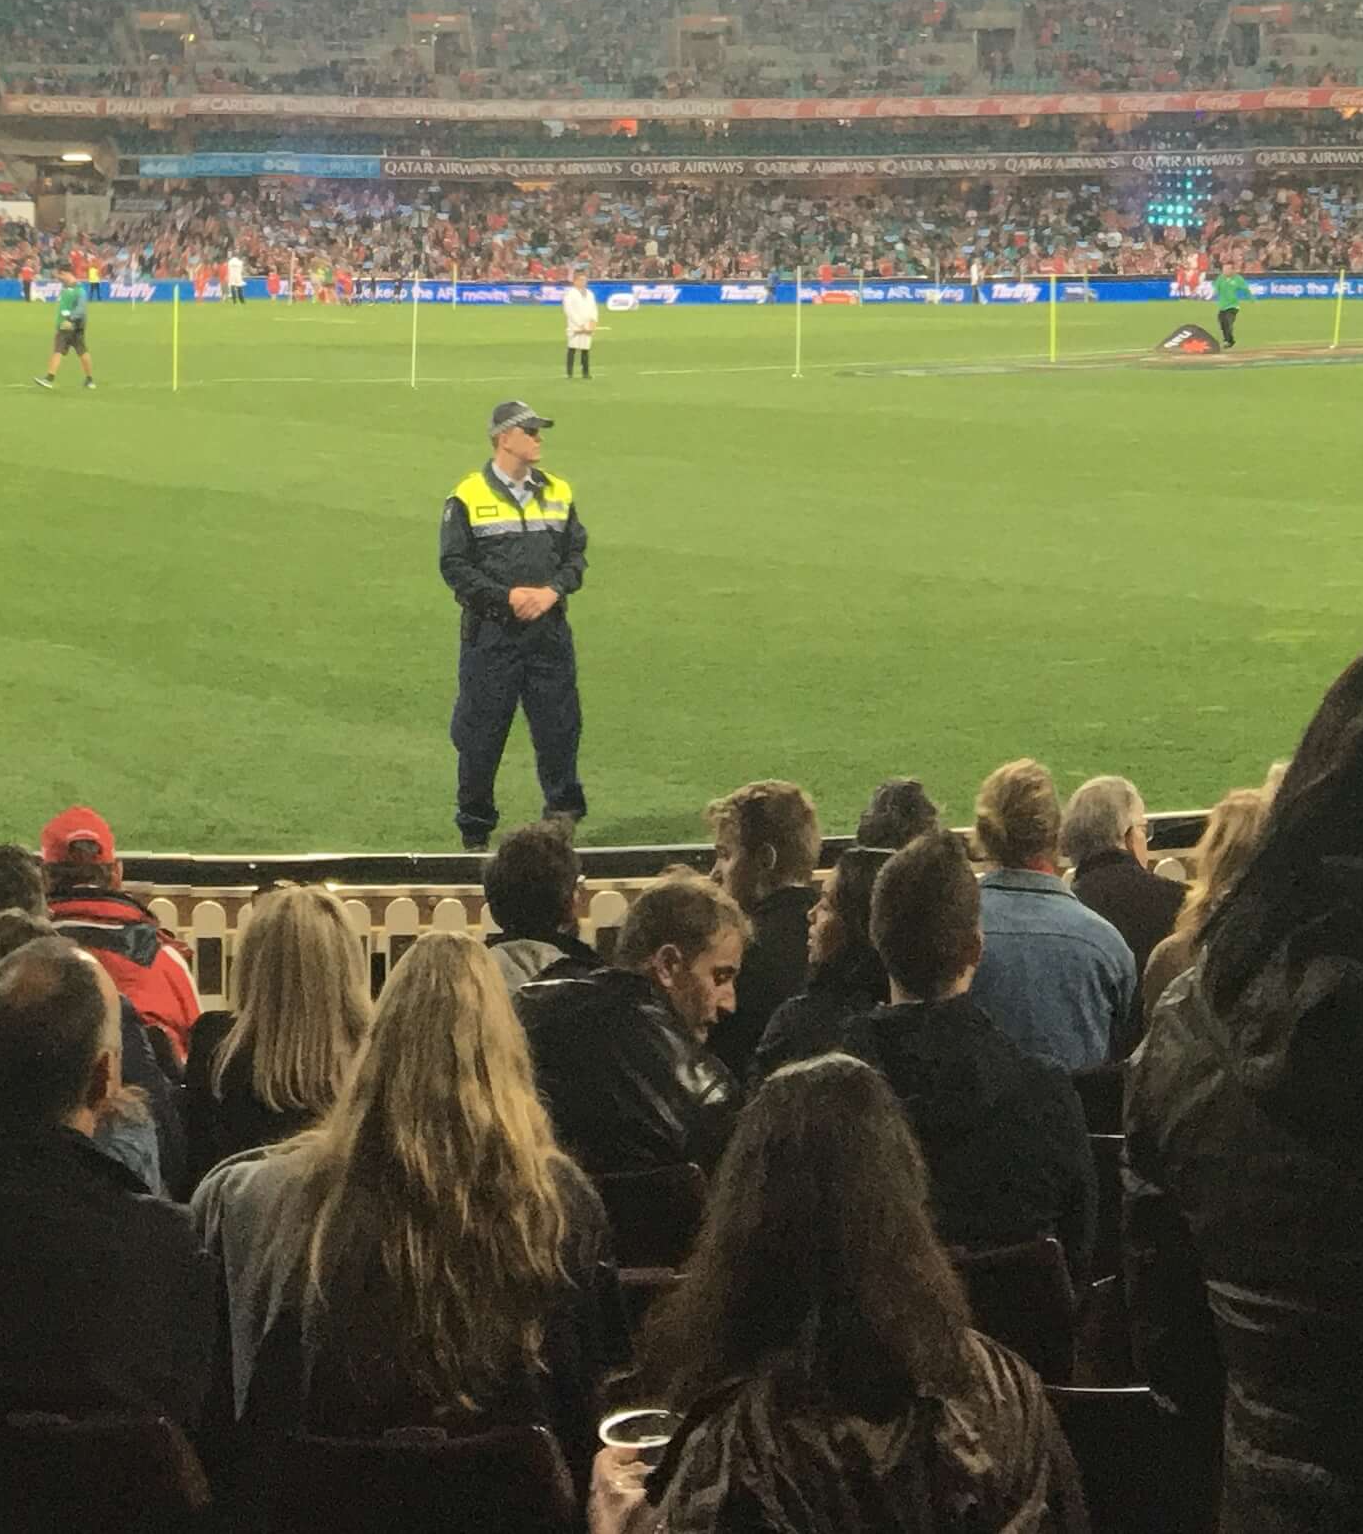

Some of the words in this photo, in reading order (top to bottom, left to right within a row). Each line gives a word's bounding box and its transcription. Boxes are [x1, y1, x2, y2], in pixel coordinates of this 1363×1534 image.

[29, 99, 96, 114] CARLTON
[106, 99, 176, 114] DRAUGHT
[1005, 158, 1052, 172] QATAR
[1183, 154, 1244, 168] AIRWAYS
[1256, 152, 1307, 166] QATAR
[385, 161, 434, 175] QATAR
[506, 163, 554, 176] QATAR
[630, 162, 680, 175] QATAR
[683, 162, 744, 174] AIRWAYS
[883, 160, 933, 174] QATAR
[109, 281, 156, 302] Thrifty
[632, 284, 682, 304] Thrifty
[863, 287, 884, 300] the
[887, 287, 912, 300] AFL
[991, 282, 1041, 303] Thrifty
[1271, 282, 1304, 297] keep
[1306, 282, 1328, 295] the
[1332, 282, 1355, 295] AFL
